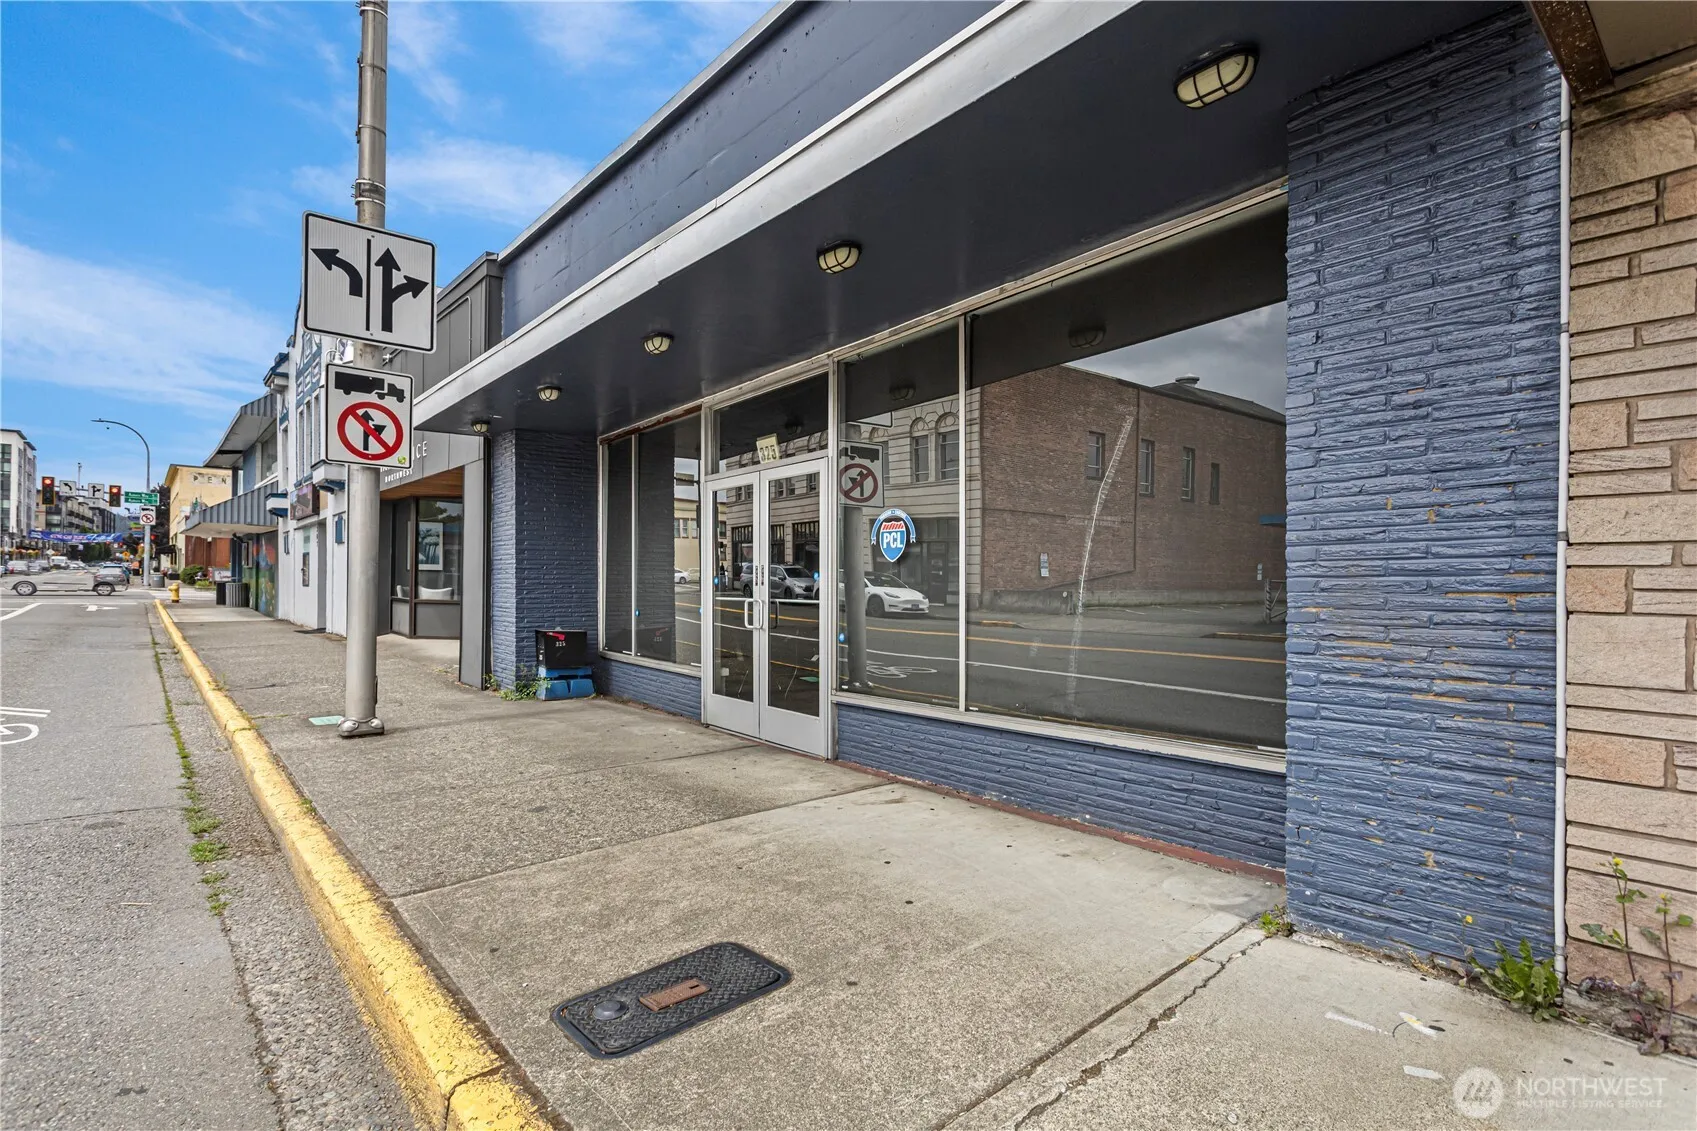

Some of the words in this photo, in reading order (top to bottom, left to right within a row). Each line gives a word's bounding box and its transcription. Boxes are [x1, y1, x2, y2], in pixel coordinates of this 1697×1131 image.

[415, 440, 428, 458] CE
[760, 444, 777, 462] 325
[883, 532, 904, 549] PCL
